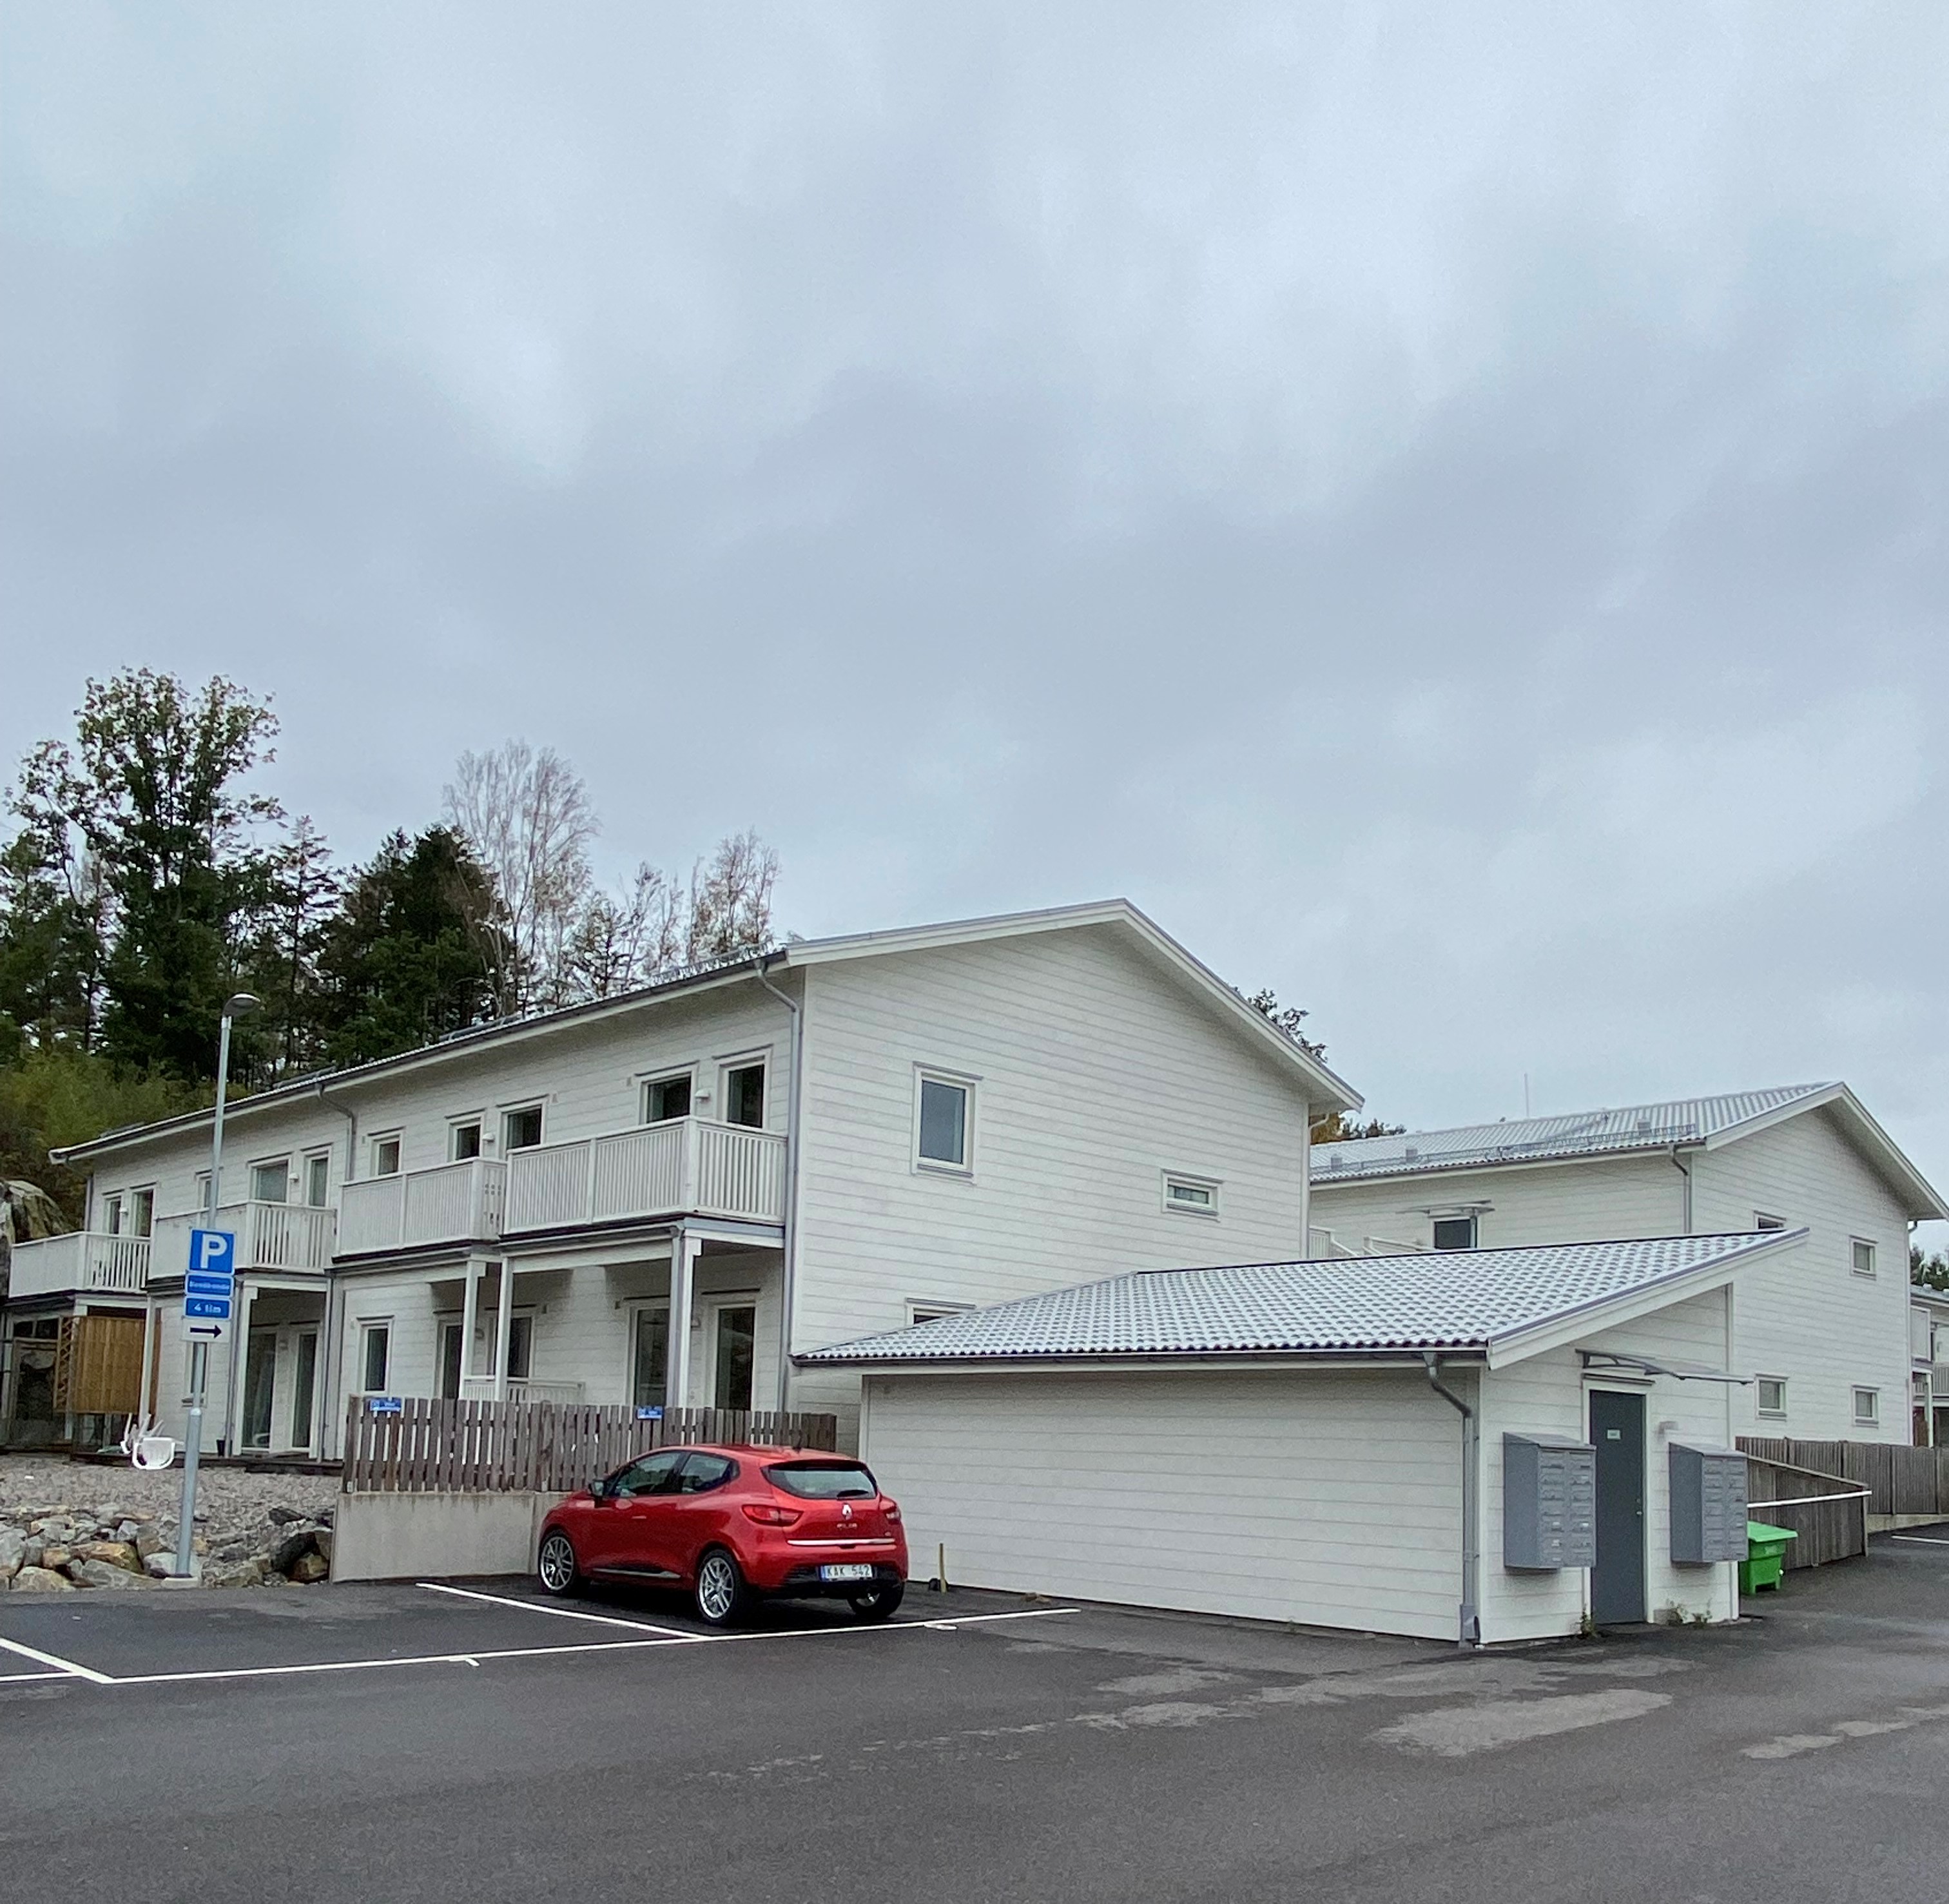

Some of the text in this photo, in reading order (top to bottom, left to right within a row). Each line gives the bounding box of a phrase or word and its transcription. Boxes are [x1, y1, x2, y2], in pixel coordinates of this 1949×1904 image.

[200, 1233, 228, 1268] P
[194, 1303, 202, 1312] 4
[827, 1564, 870, 1577] KAK 542
